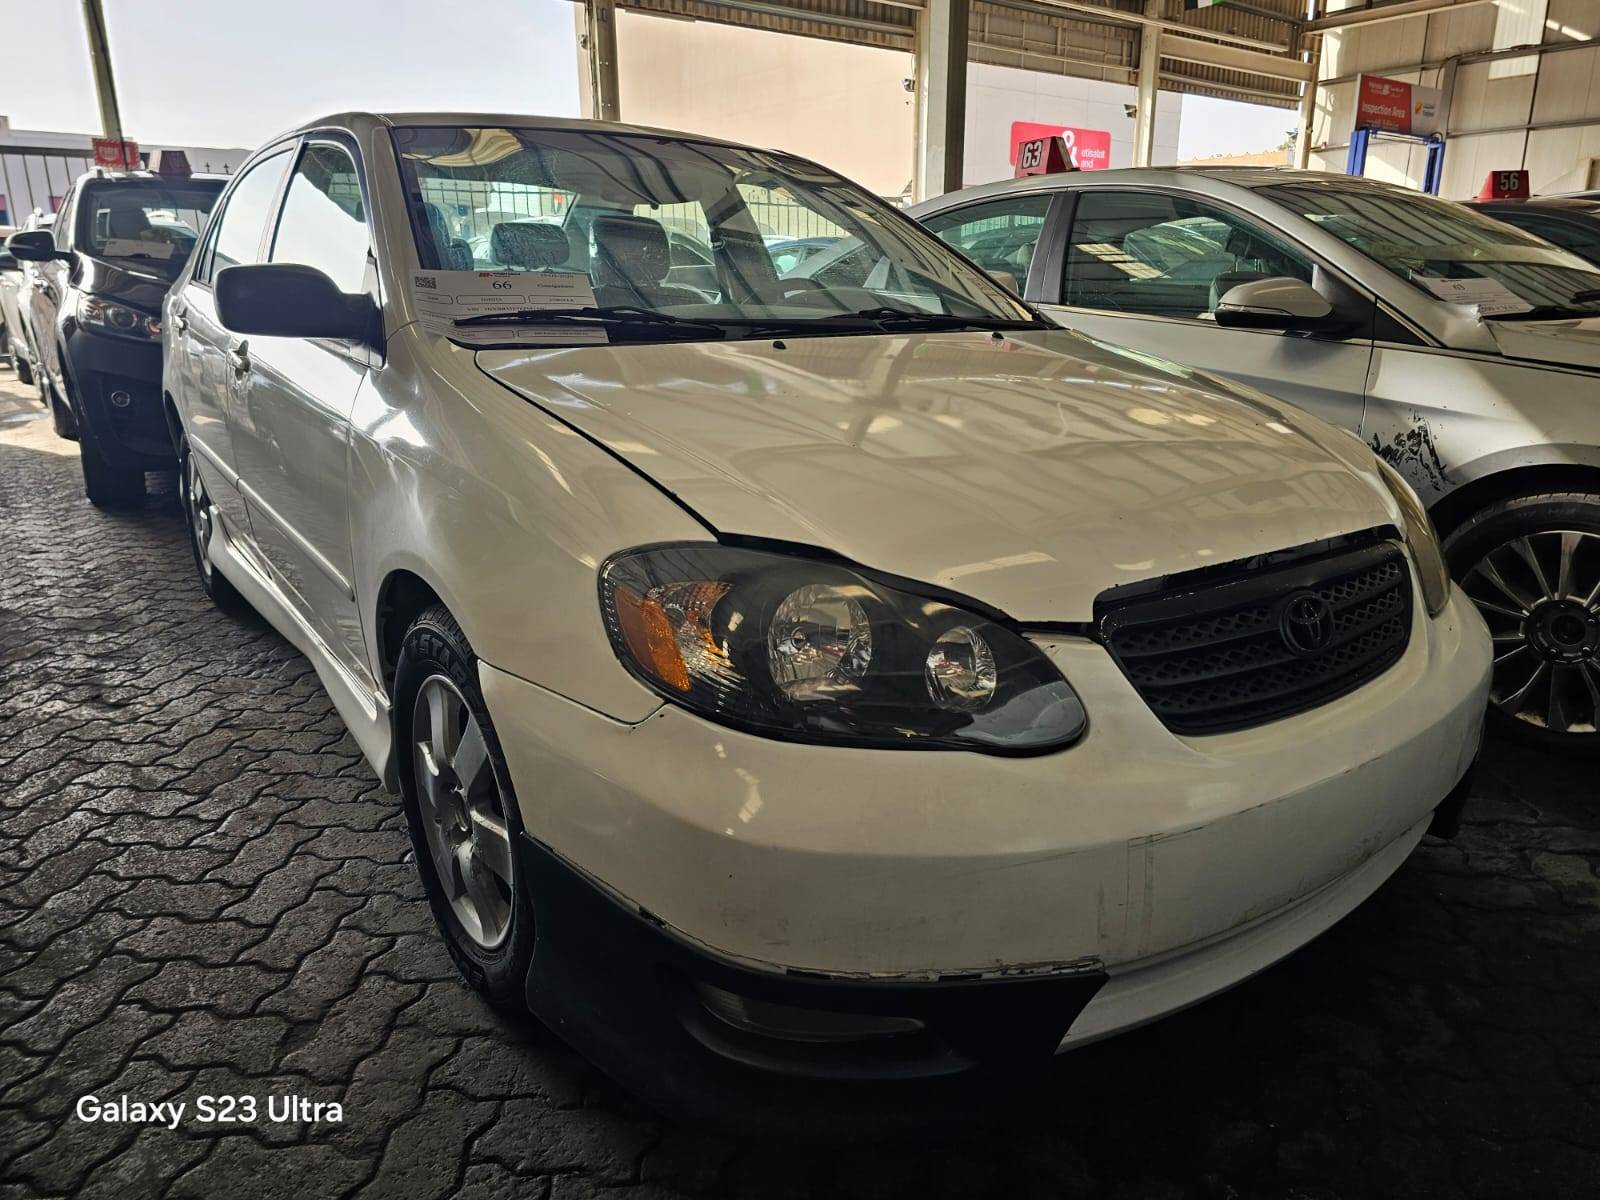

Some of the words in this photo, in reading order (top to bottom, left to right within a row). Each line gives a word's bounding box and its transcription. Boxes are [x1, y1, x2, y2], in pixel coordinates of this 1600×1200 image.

[1362, 101, 1392, 116] Inspection
[1392, 105, 1406, 119] Area
[1022, 140, 1042, 168] 63
[1500, 172, 1519, 190] 56
[492, 280, 512, 290] 66
